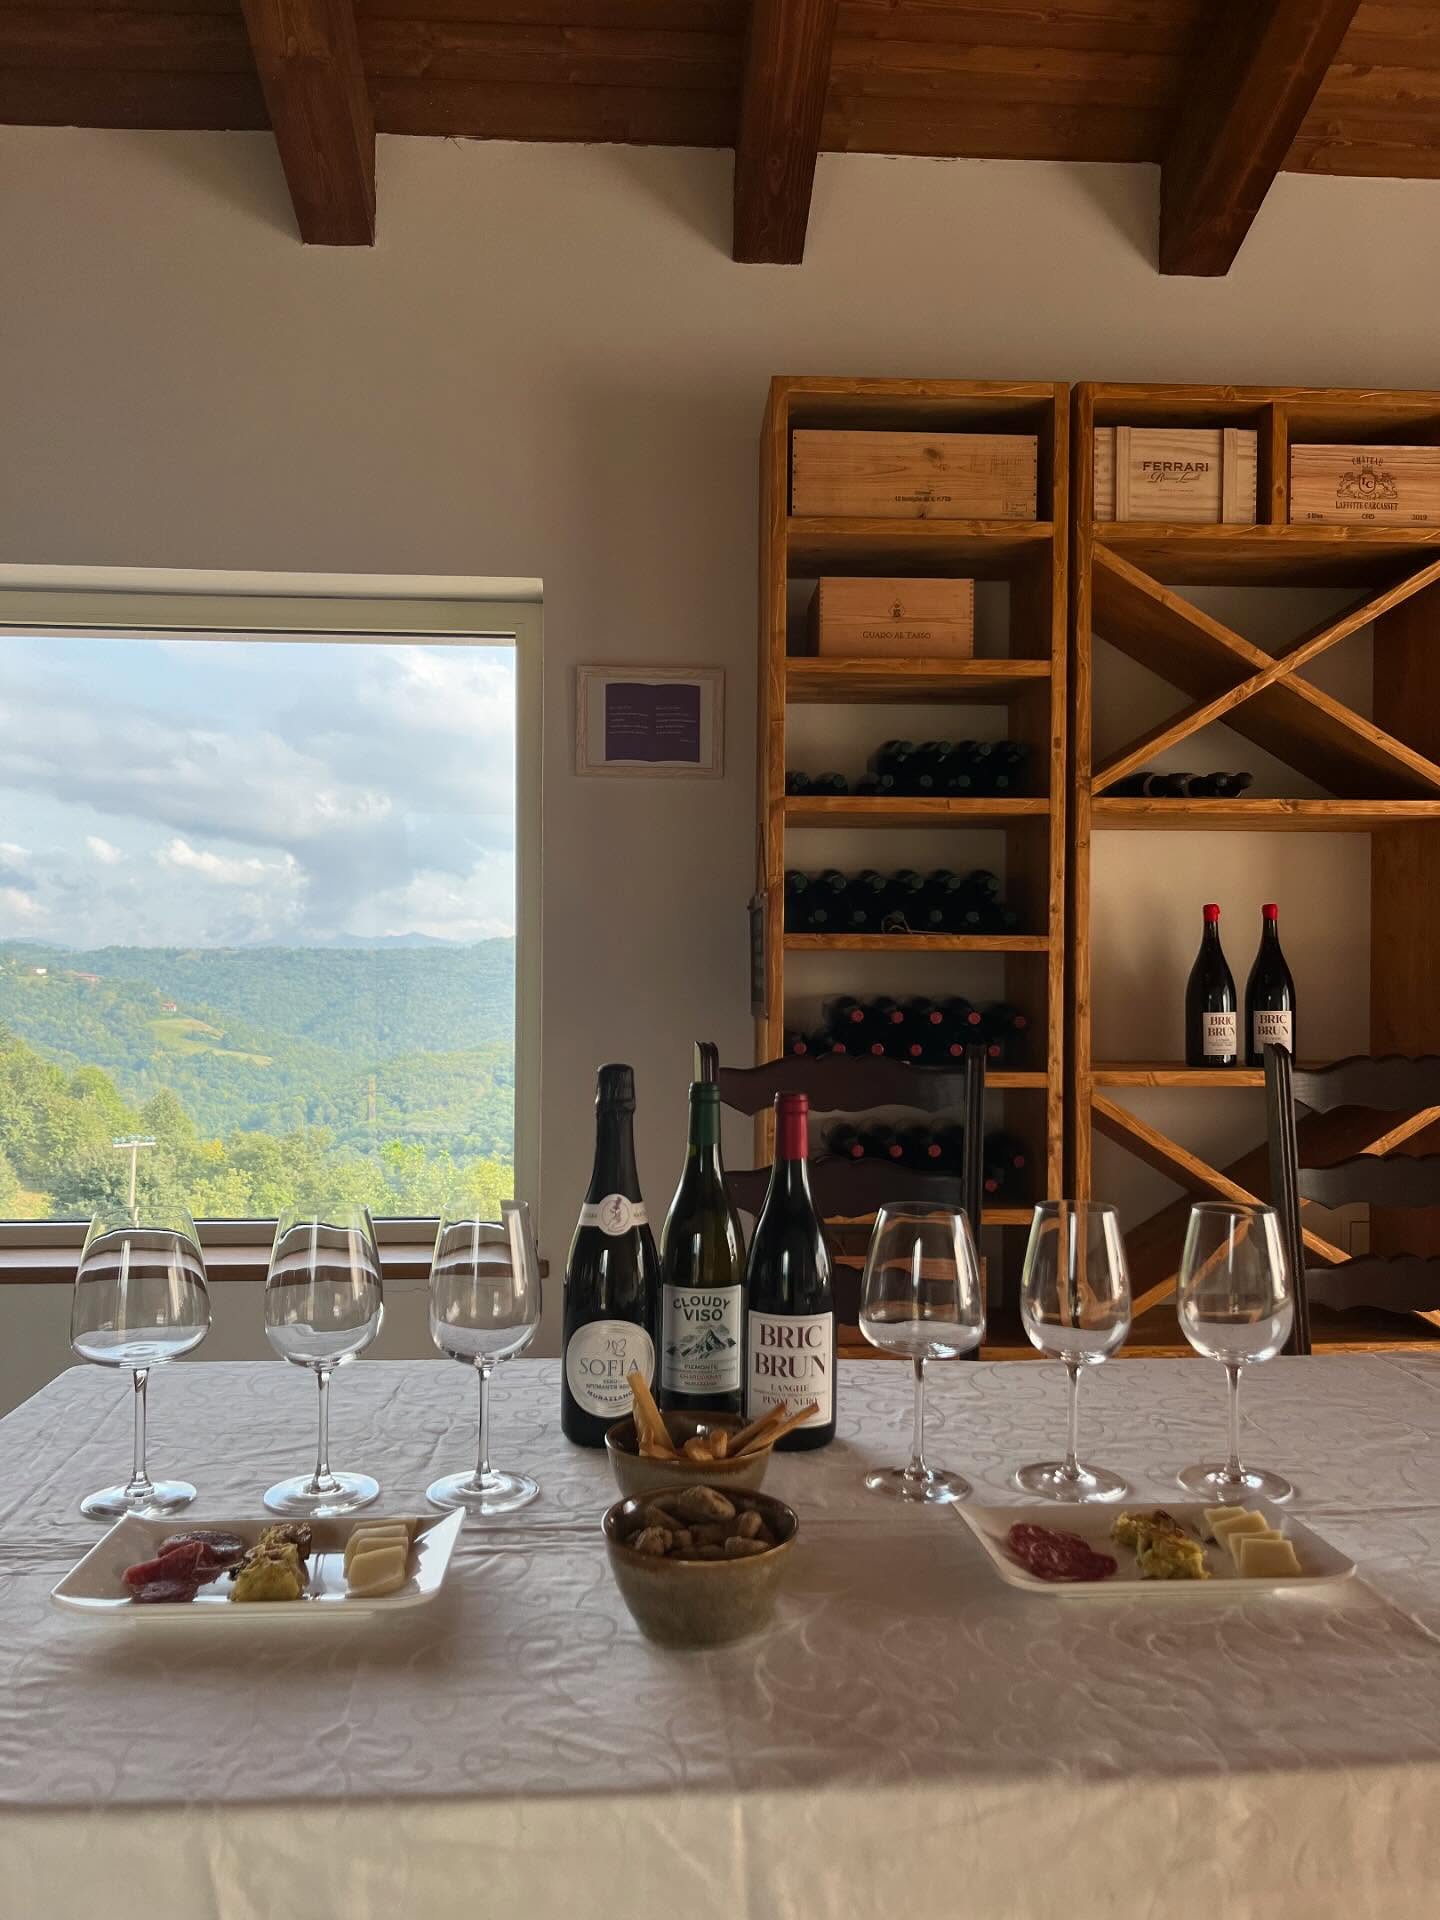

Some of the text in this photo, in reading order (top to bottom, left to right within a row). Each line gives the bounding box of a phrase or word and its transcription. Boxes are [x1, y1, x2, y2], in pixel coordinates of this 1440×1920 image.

[1143, 461, 1209, 472] FERRARI
[1210, 1016, 1234, 1026] BRIC
[1260, 1014, 1288, 1024] BRIC
[1257, 1025, 1289, 1035] BRUN
[672, 1295, 731, 1310] CLOUDY
[683, 1308, 723, 1322] VISO
[760, 1323, 823, 1349] BRIC
[578, 1357, 640, 1377] SOFIA
[754, 1352, 827, 1379] BRUN
[770, 1384, 809, 1393] LANGHE
